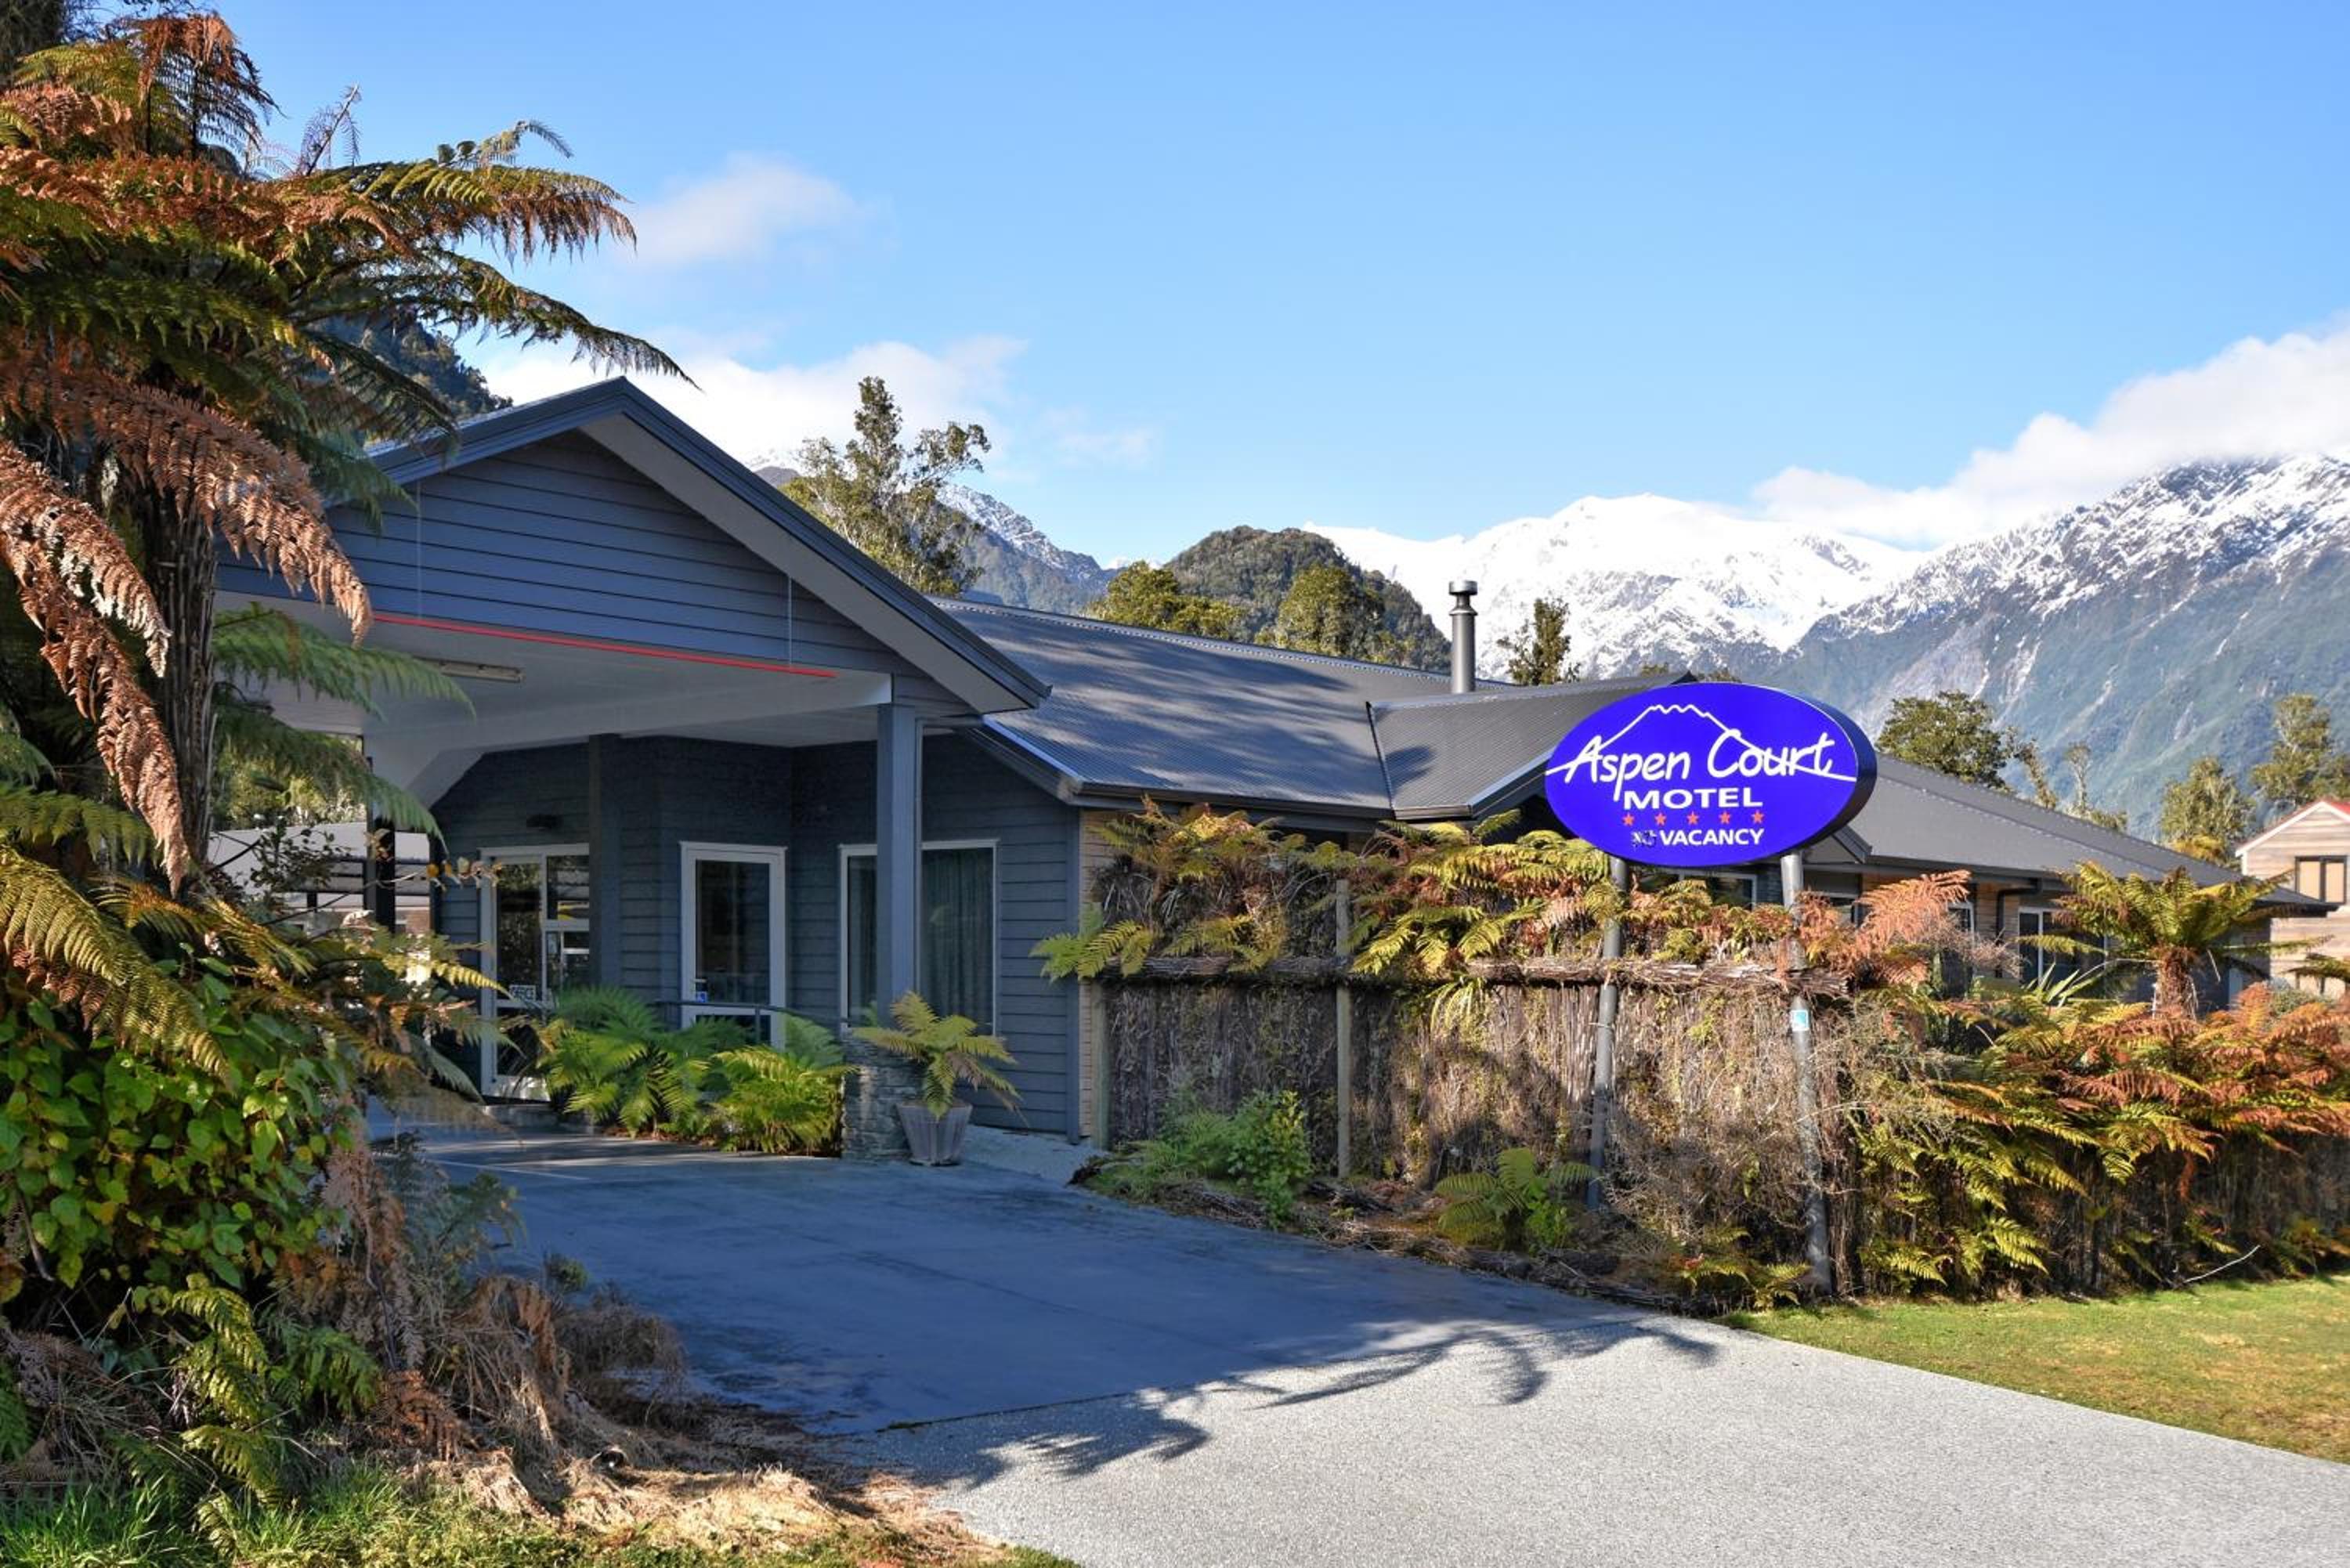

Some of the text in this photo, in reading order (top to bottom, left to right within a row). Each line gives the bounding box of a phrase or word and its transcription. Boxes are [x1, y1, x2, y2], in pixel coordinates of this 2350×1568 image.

[1563, 729, 1835, 802] Aspen Court
[1624, 787, 1763, 810] MOTEL
[1660, 829, 1764, 846] VACANCY
